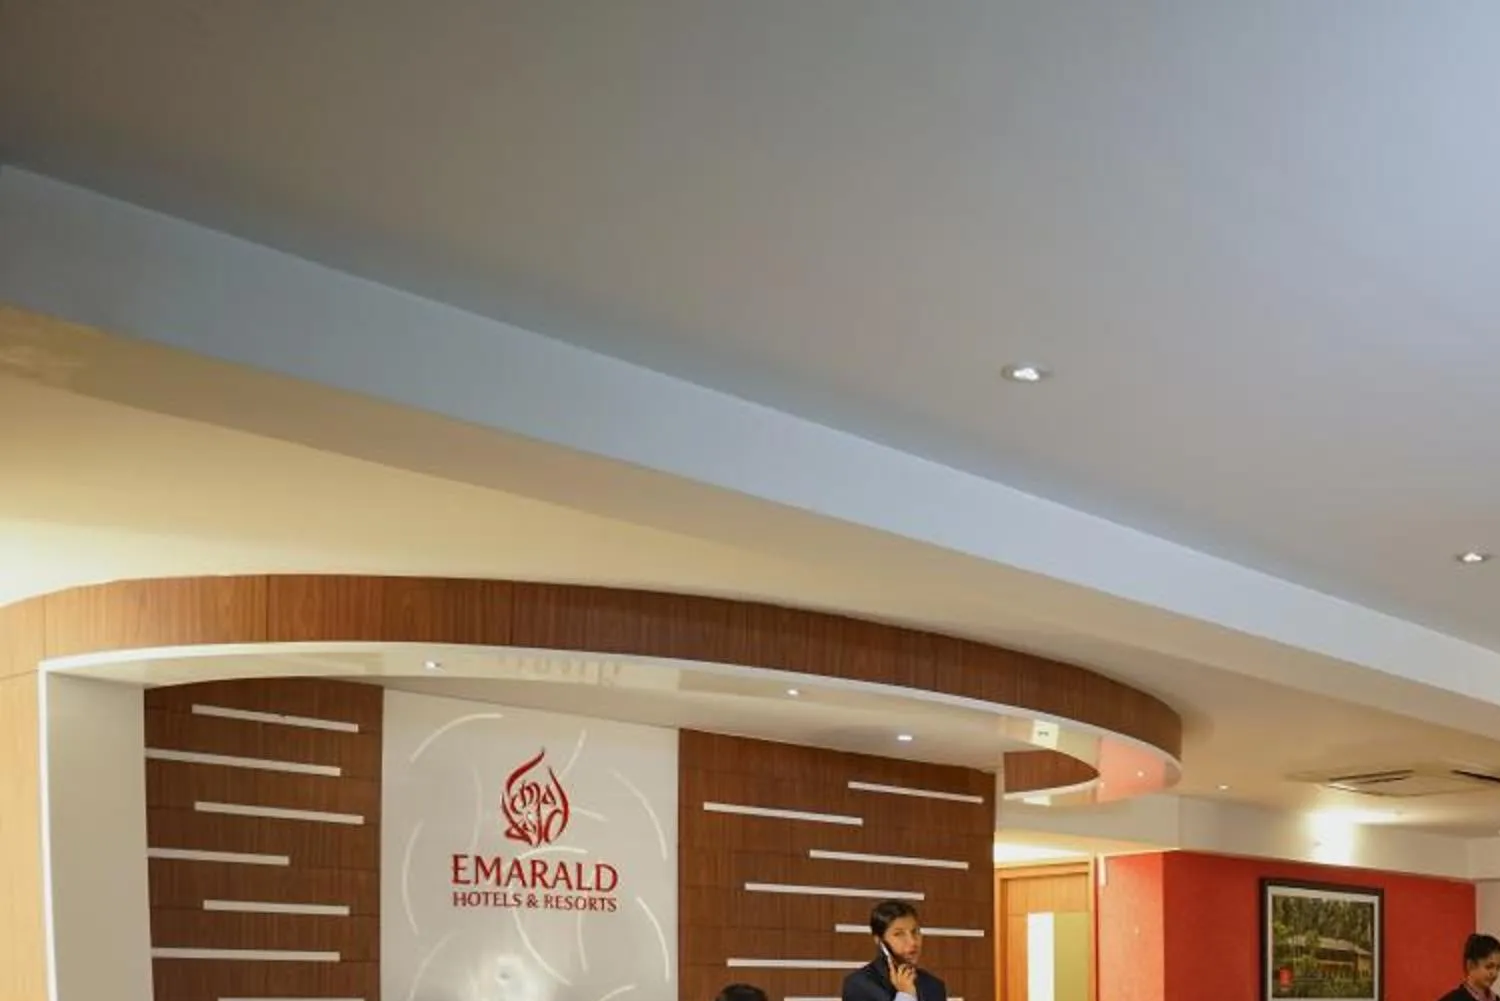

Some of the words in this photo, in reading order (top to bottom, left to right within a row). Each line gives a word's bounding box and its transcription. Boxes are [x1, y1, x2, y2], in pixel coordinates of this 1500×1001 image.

[452, 854, 618, 893] EMARALD
[453, 891, 522, 908] HOTELS
[526, 893, 539, 908] &
[543, 894, 617, 912] RESORTS
